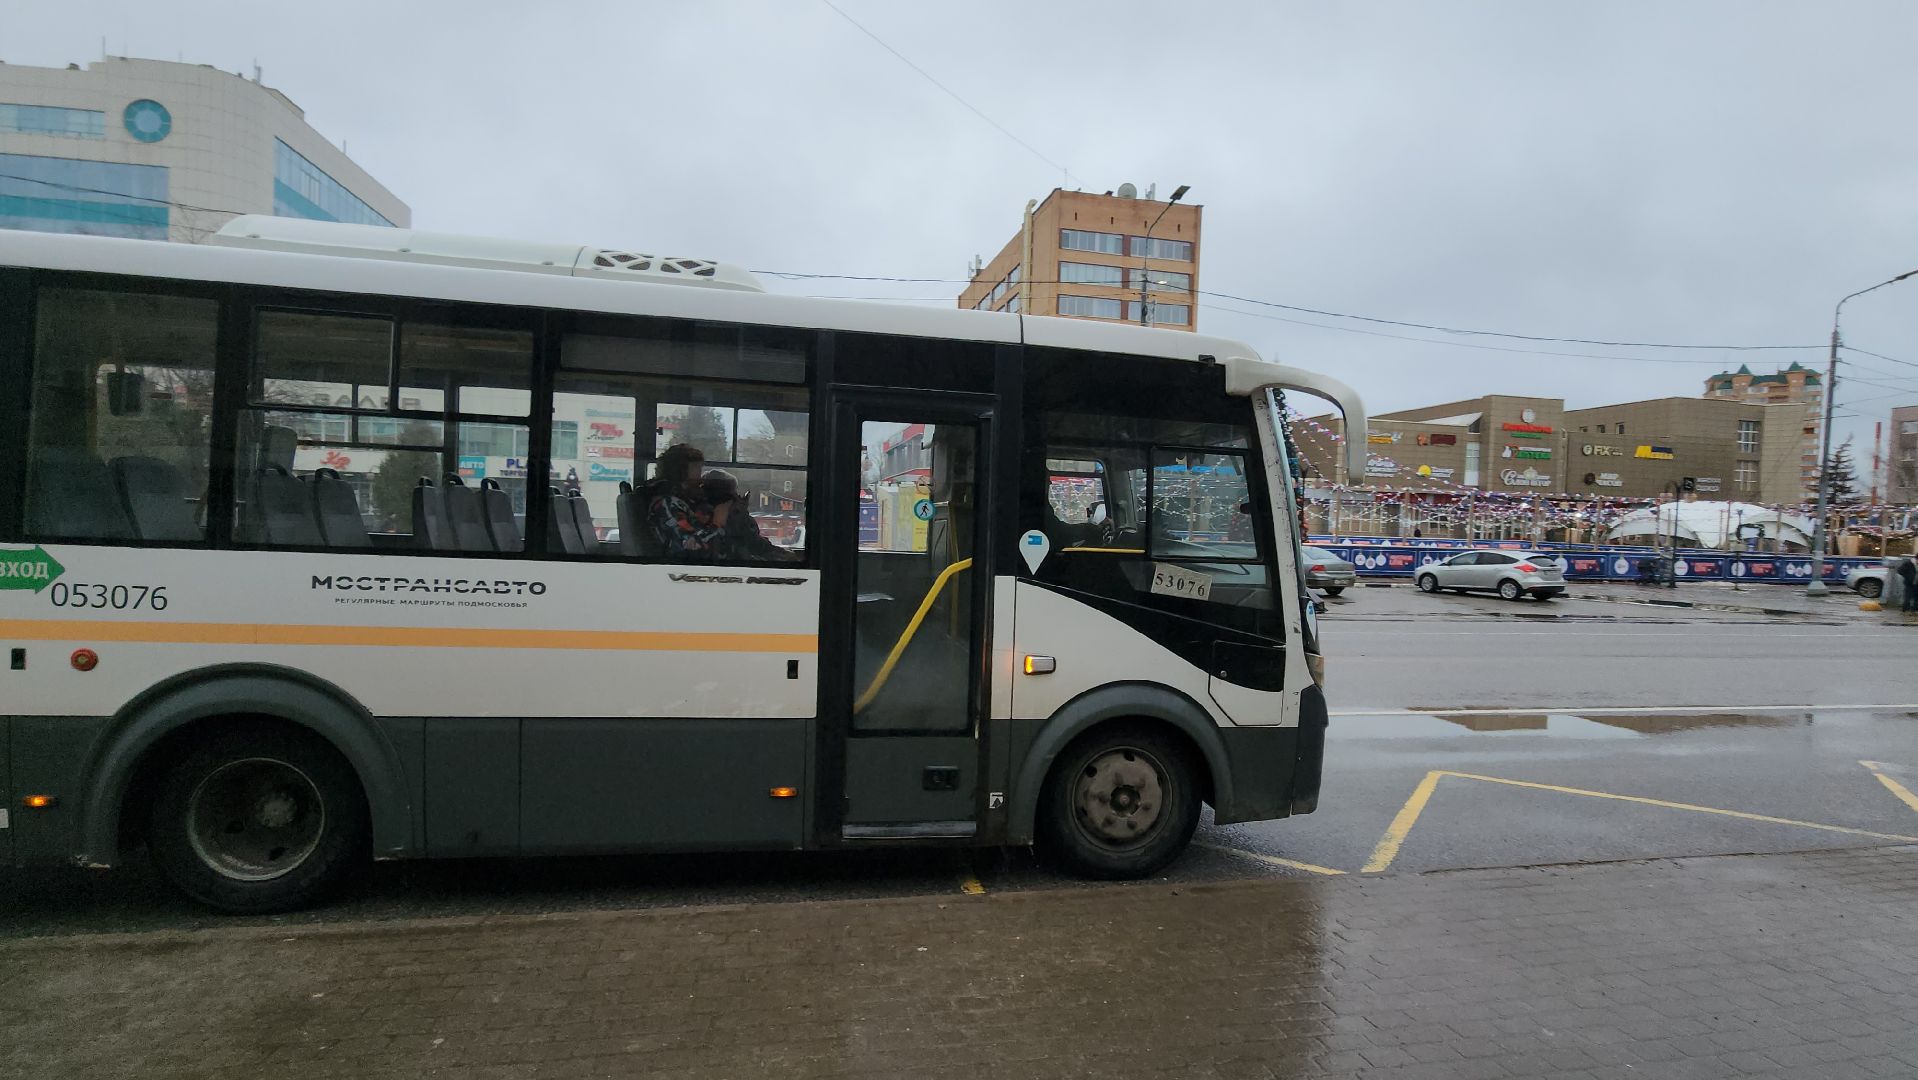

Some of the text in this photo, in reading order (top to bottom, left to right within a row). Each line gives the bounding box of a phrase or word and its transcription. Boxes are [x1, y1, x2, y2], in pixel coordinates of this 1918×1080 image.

[312, 575, 546, 595] МОСТРАНСАВТО
[1155, 573, 1205, 596] 53076
[51, 582, 168, 610] 053076
[458, 600, 528, 608] ПОДМОСКОВЬЯ
